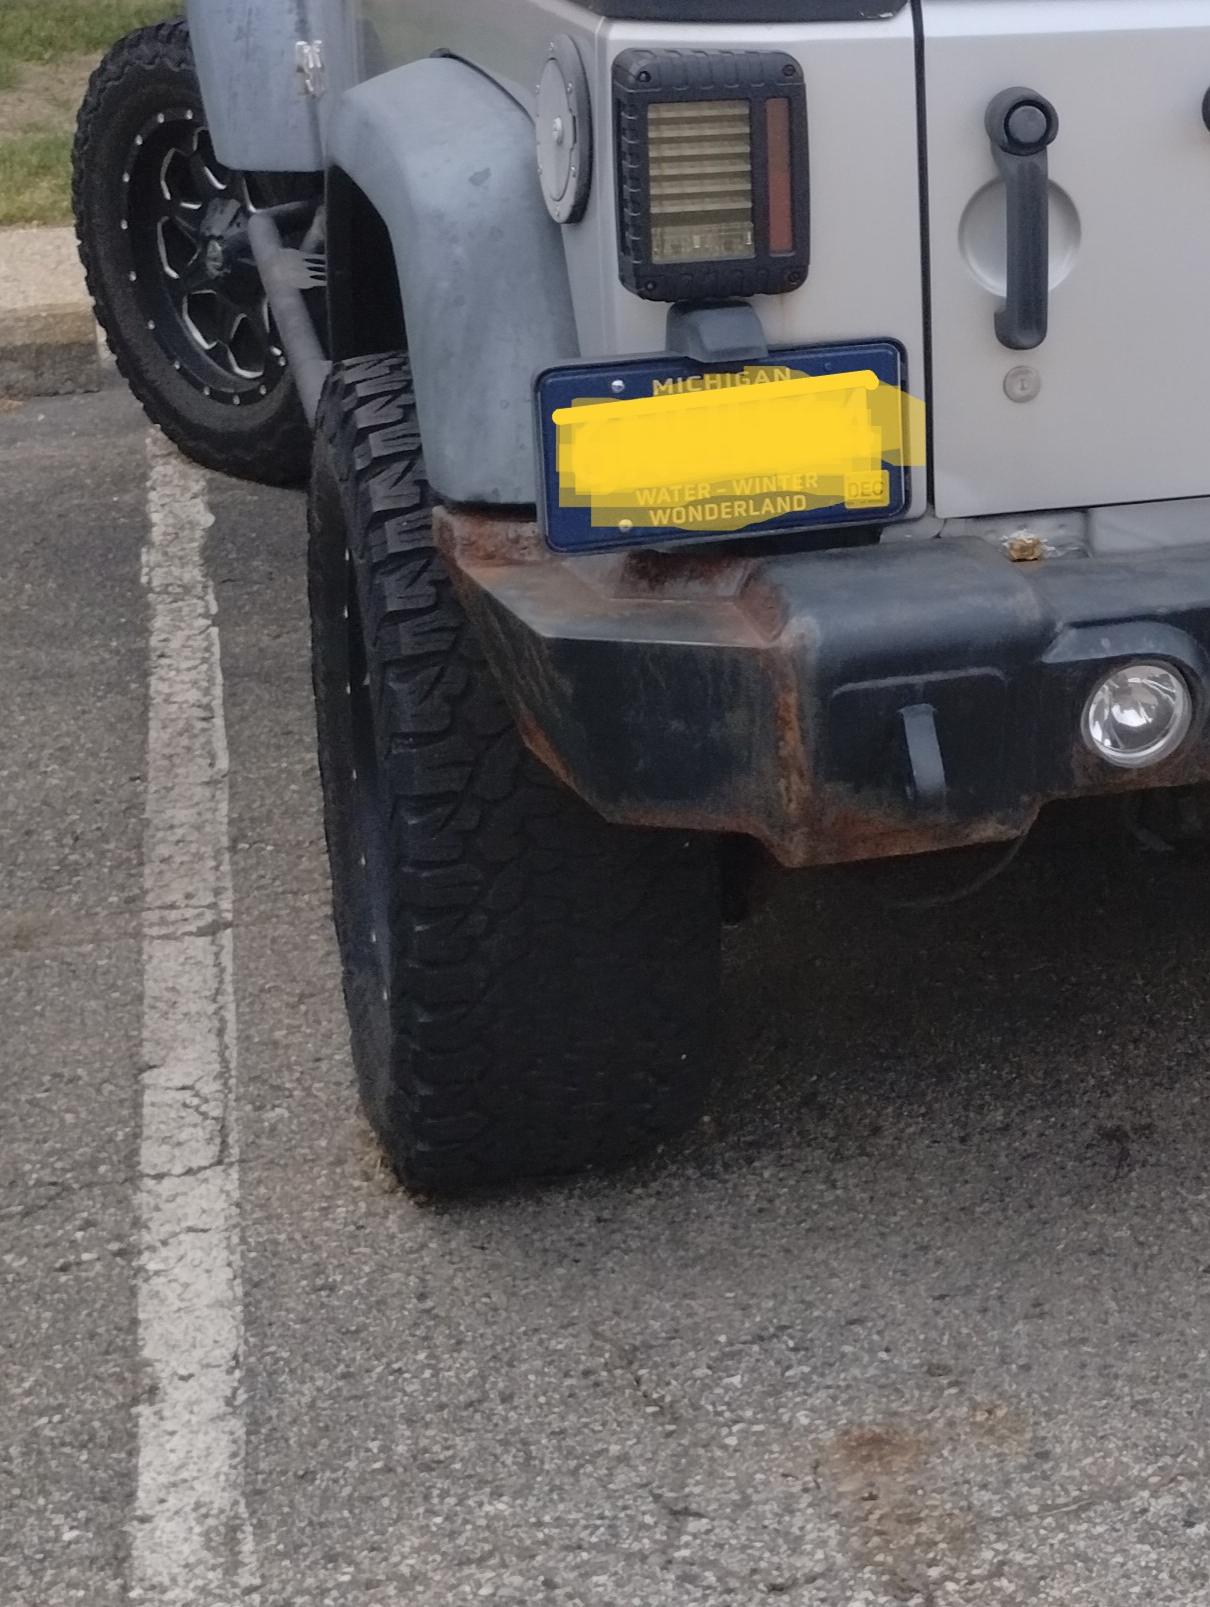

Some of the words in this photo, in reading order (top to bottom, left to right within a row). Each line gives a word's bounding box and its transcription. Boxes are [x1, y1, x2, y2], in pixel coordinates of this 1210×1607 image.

[652, 367, 790, 397] MICHIGAN
[635, 482, 711, 506] WATER
[731, 472, 819, 496] WINTER
[847, 480, 883, 498] DEC
[648, 494, 807, 527] WONDERLAND
